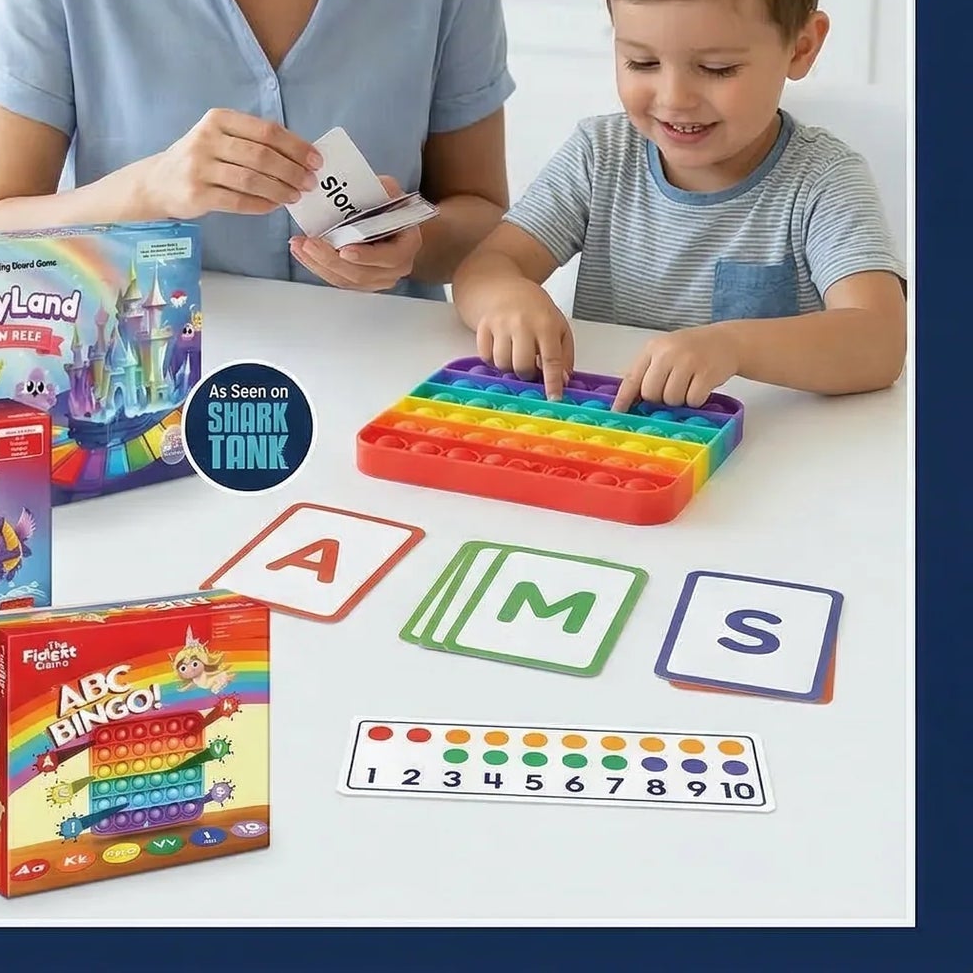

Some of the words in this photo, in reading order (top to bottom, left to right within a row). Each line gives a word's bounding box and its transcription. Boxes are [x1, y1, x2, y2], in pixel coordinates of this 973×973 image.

[266, 538, 340, 584] A
[496, 581, 597, 634] M
[717, 609, 782, 656] S
[48, 684, 162, 747] BINGO!
[58, 665, 132, 717] ABC
[368, 767, 378, 784] 1
[401, 768, 421, 786] 2
[442, 770, 462, 788] 3
[483, 772, 504, 789] 4
[525, 774, 545, 792] 5
[565, 775, 585, 793] 6
[606, 777, 625, 794] 7
[646, 778, 667, 796] 8
[687, 780, 708, 798] 9
[720, 782, 756, 801] 10
